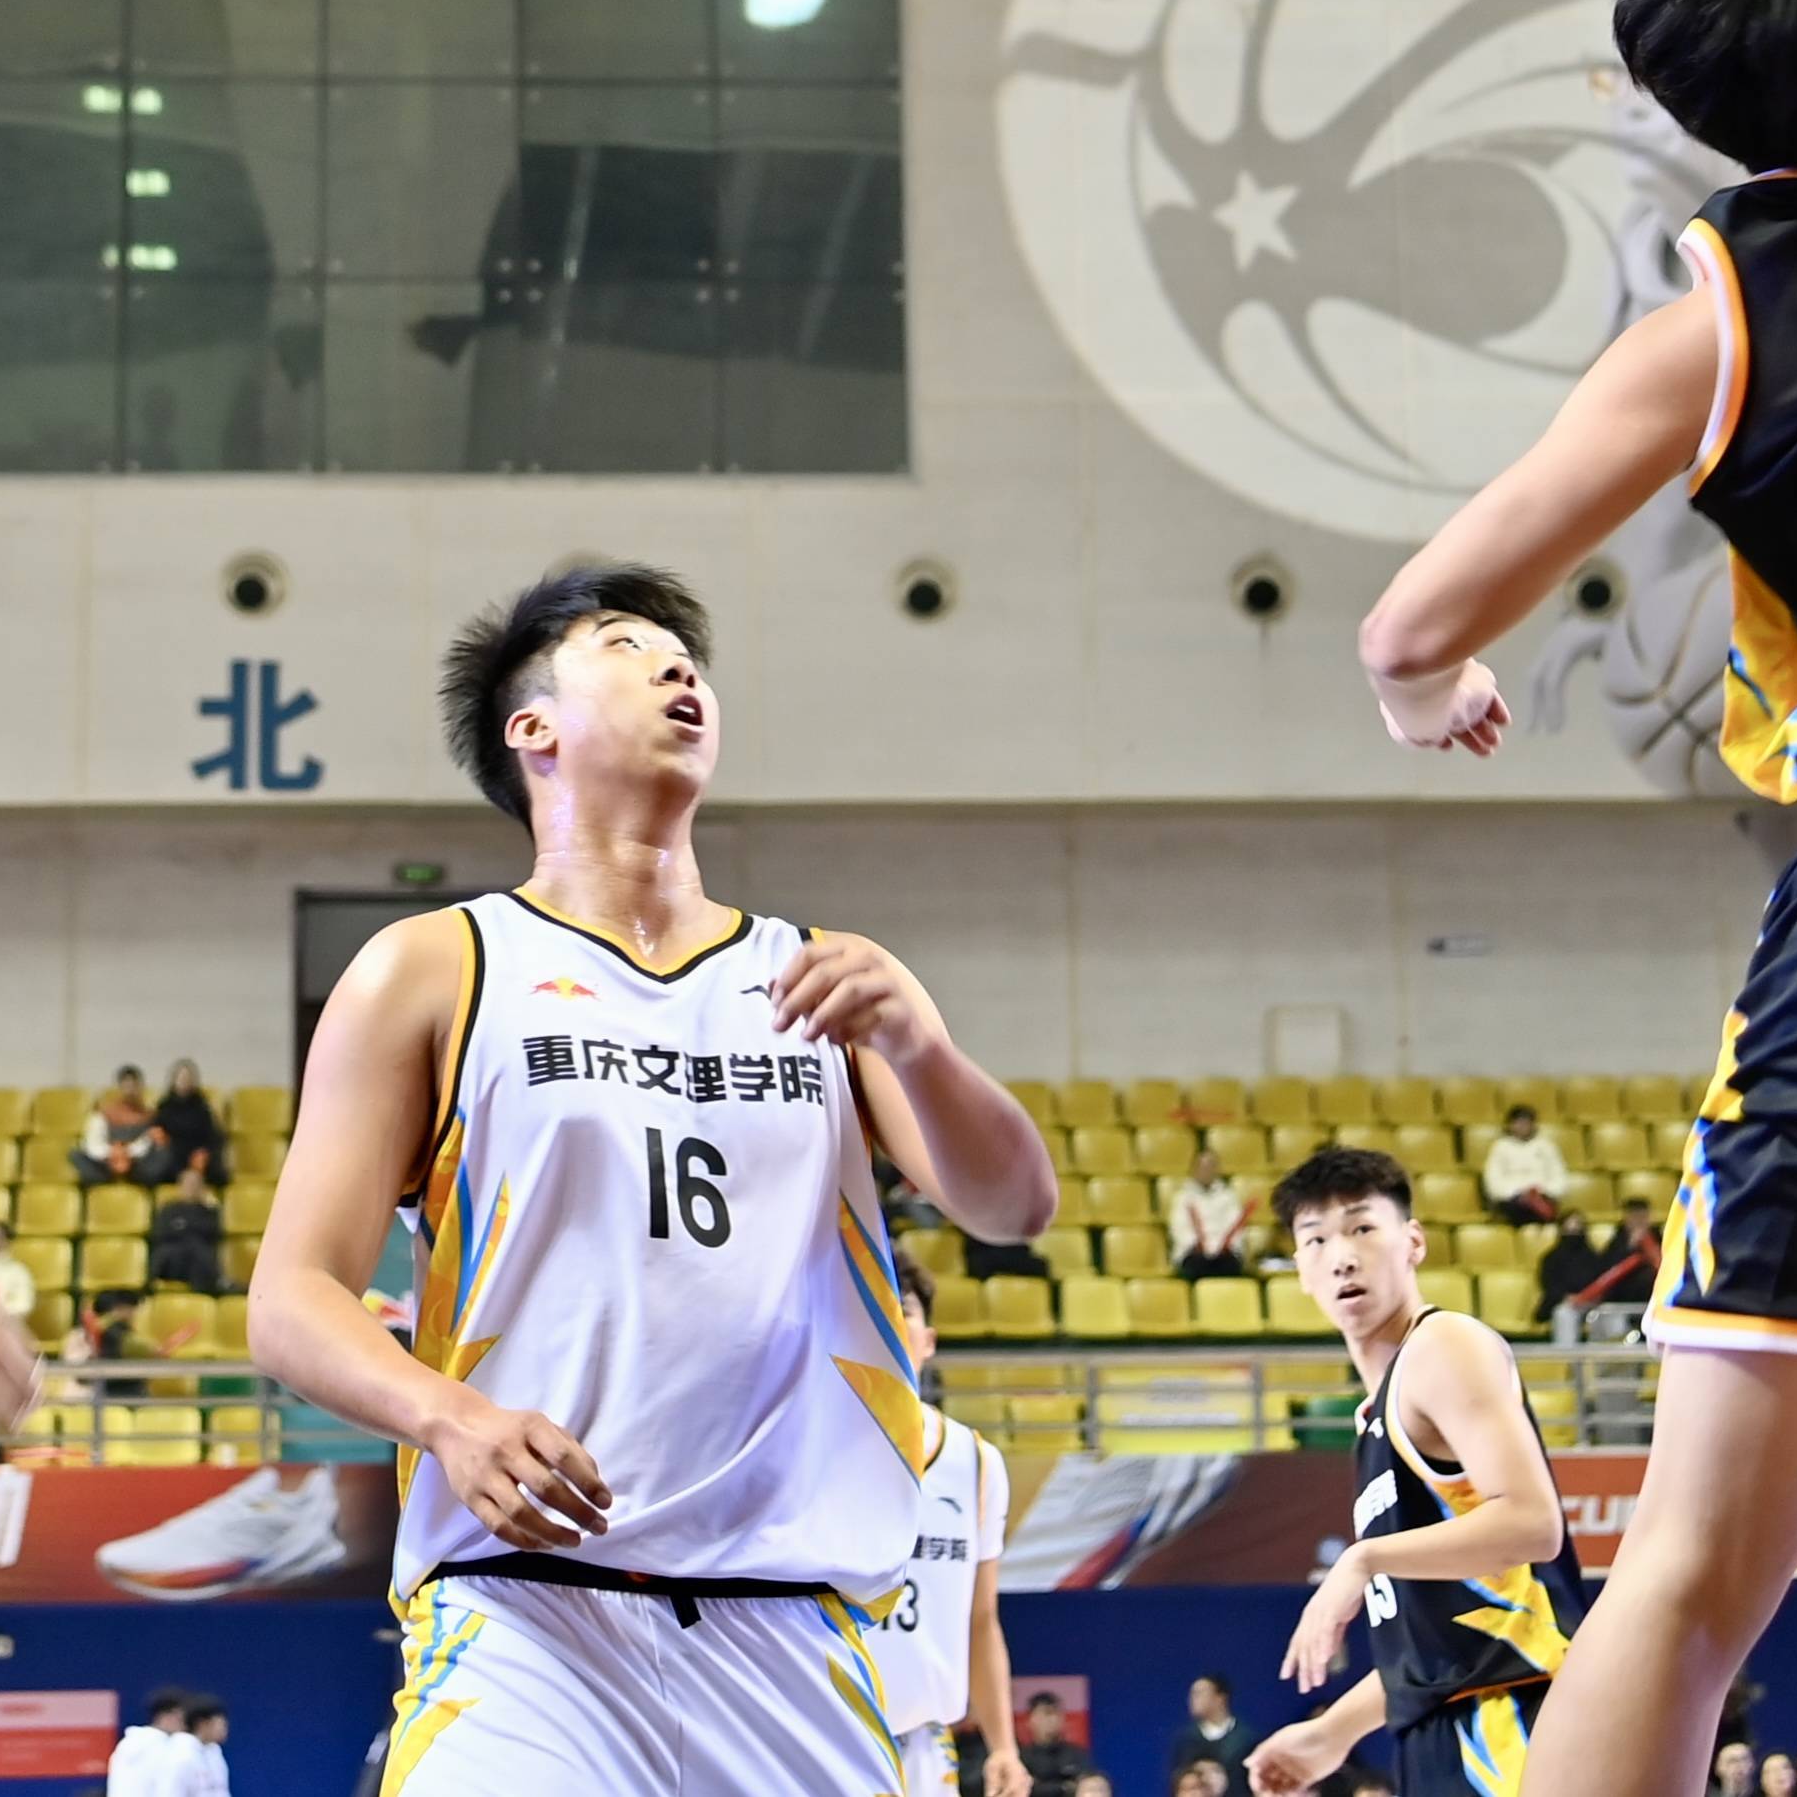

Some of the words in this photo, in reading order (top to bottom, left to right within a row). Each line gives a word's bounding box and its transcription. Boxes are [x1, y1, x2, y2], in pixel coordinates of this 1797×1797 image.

[191, 658, 325, 792] 北
[521, 1034, 826, 1107] 重庆文理学院
[644, 1125, 732, 1249] 16
